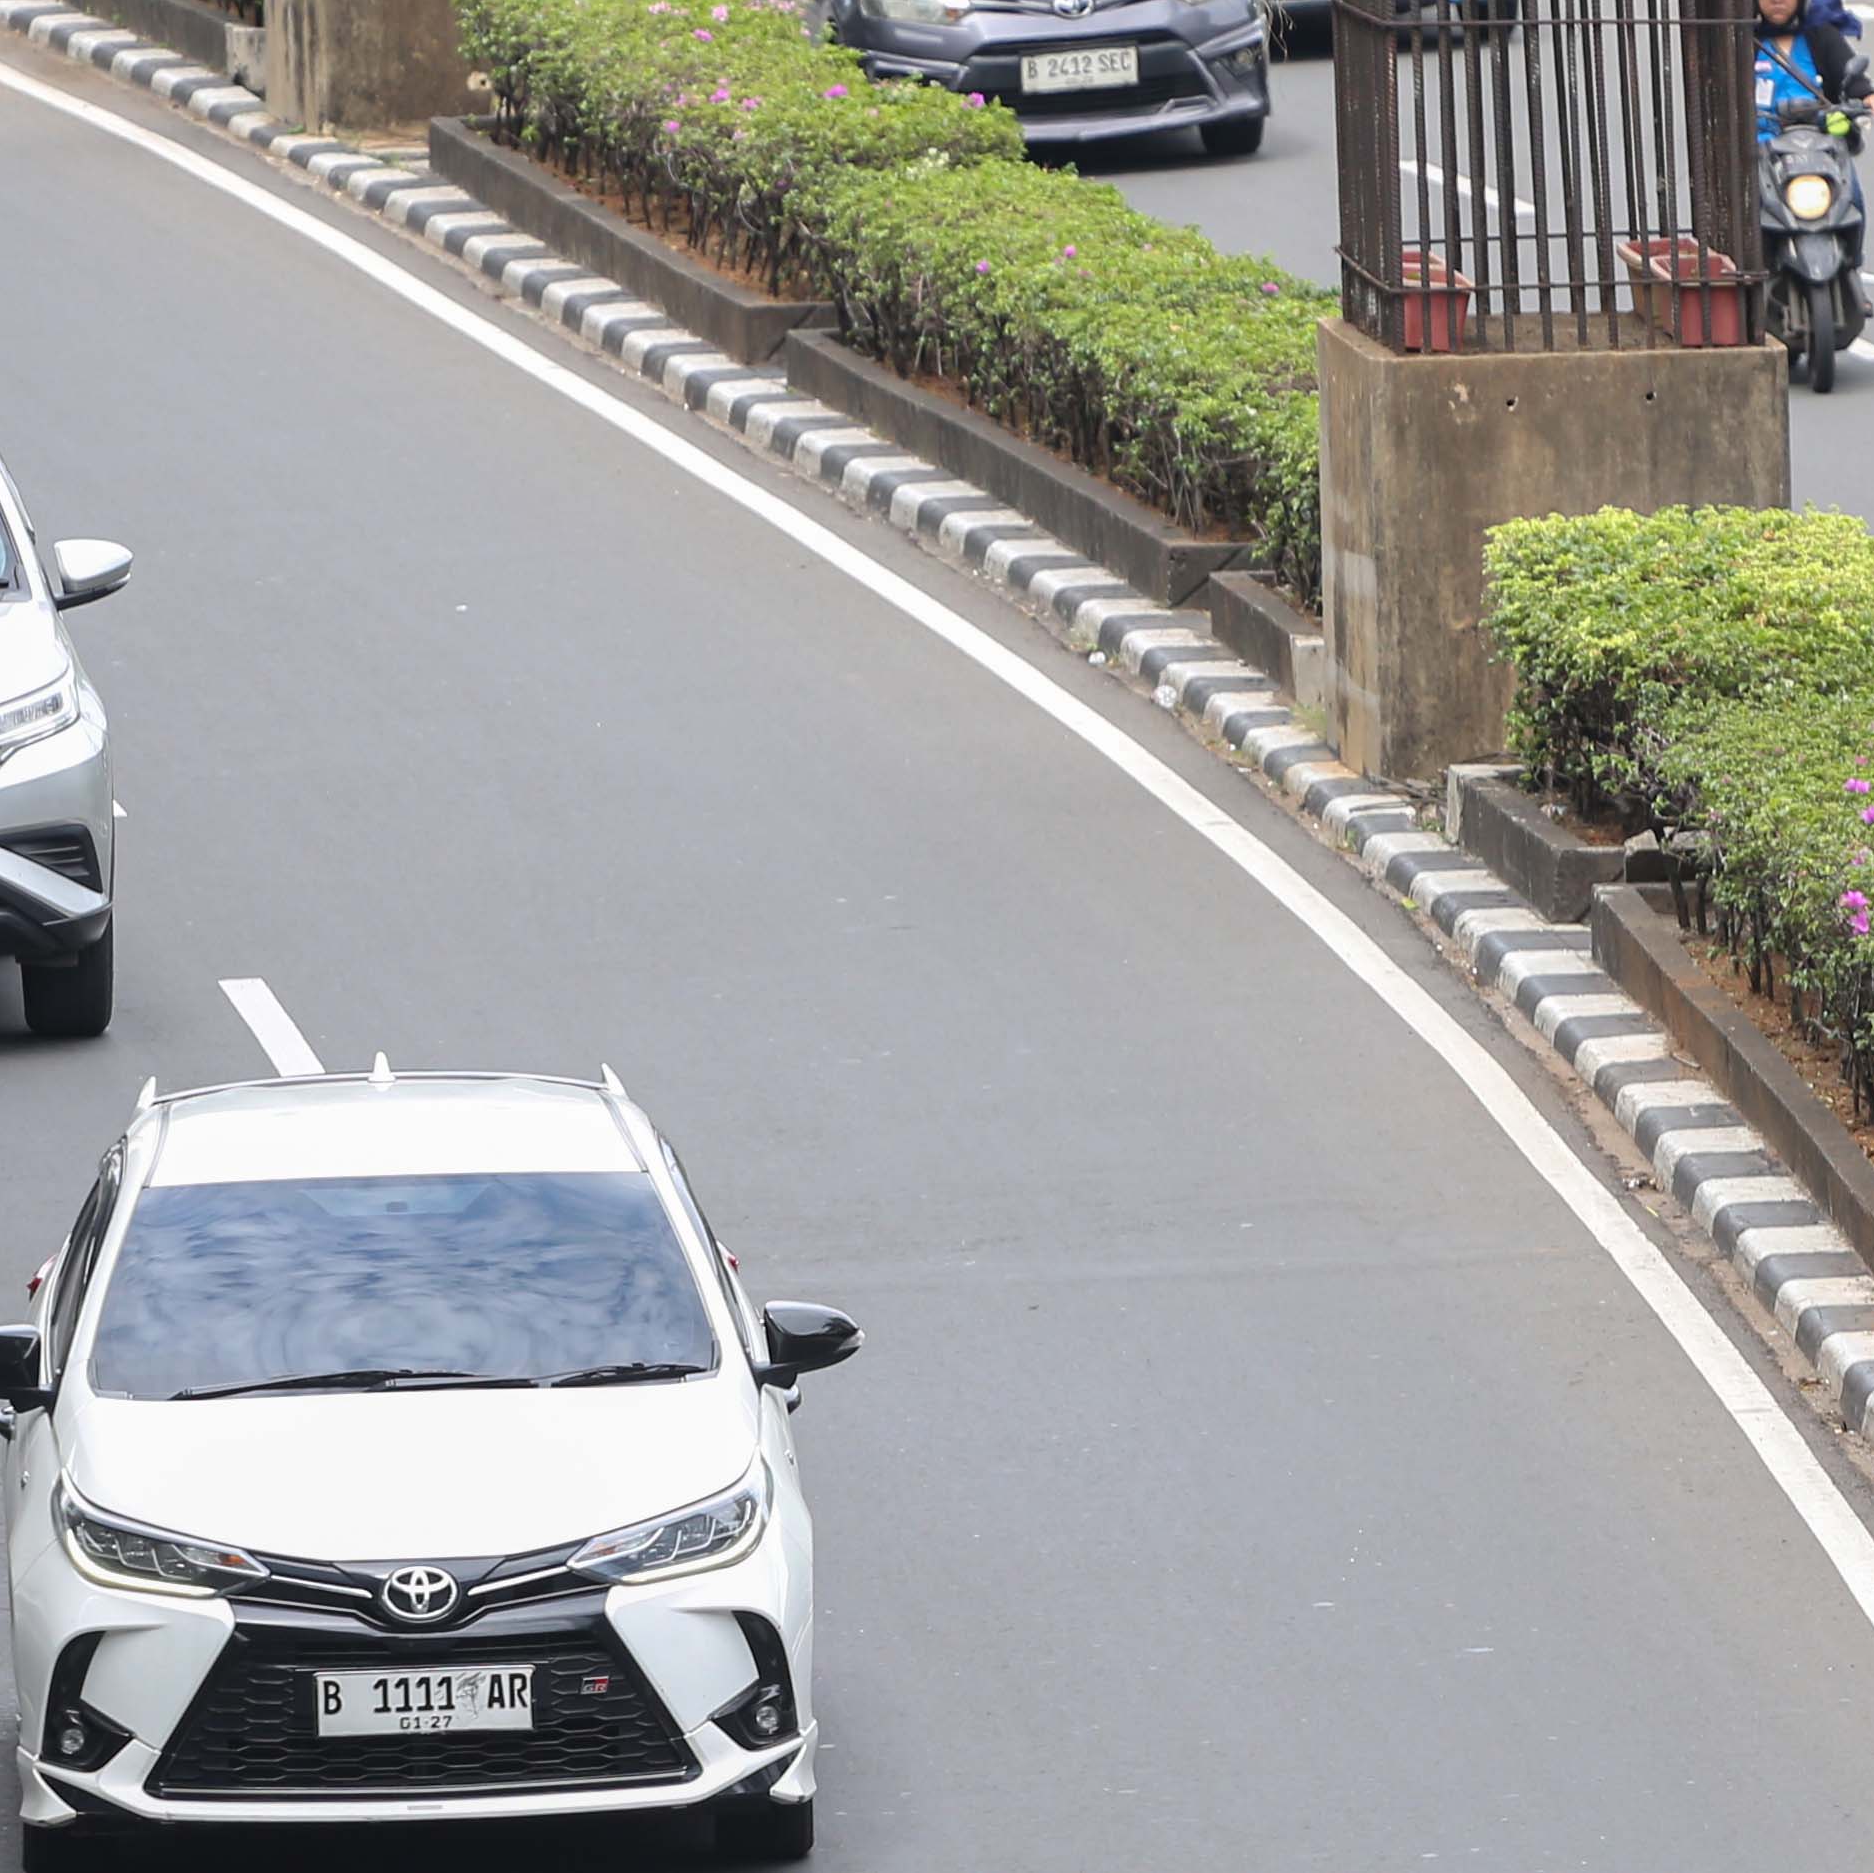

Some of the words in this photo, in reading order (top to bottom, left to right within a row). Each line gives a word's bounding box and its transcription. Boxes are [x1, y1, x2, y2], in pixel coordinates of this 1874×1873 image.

[1028, 60, 1038, 79] B
[1048, 54, 1093, 78] 2412
[323, 1680, 343, 1717] B
[372, 1676, 456, 1714] 1111
[487, 1673, 528, 1710] AR
